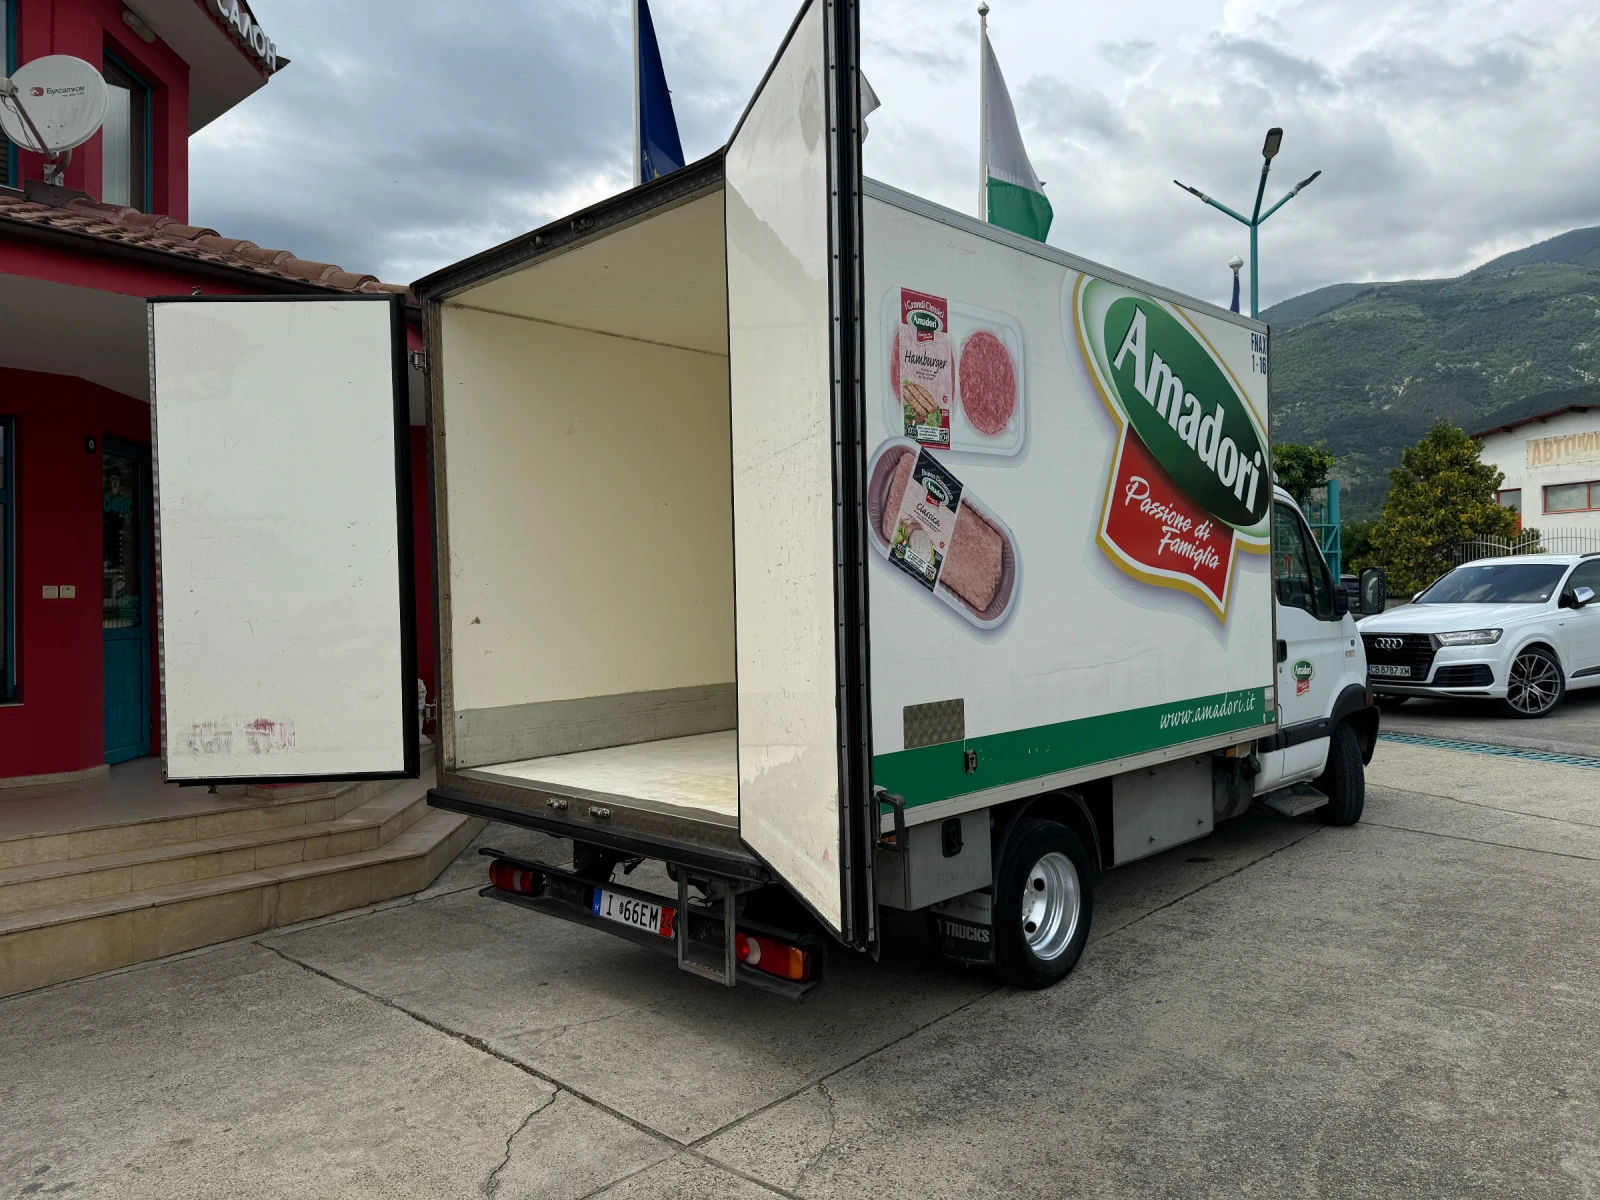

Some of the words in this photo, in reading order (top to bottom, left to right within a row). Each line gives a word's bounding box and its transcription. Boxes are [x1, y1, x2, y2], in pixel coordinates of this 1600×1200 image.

[913, 314, 938, 329] Amadori
[1251, 332, 1267, 355] FNAX
[904, 350, 947, 374] Hamburger
[1113, 306, 1262, 513] Amadori
[916, 502, 941, 527] Classica
[1125, 476, 1192, 532] Passione
[1194, 520, 1213, 541] di
[1157, 526, 1220, 571] Famiglia
[1160, 691, 1256, 729] www.amadori.it
[623, 900, 659, 930] 66EM
[945, 921, 990, 943] TRUCKS
